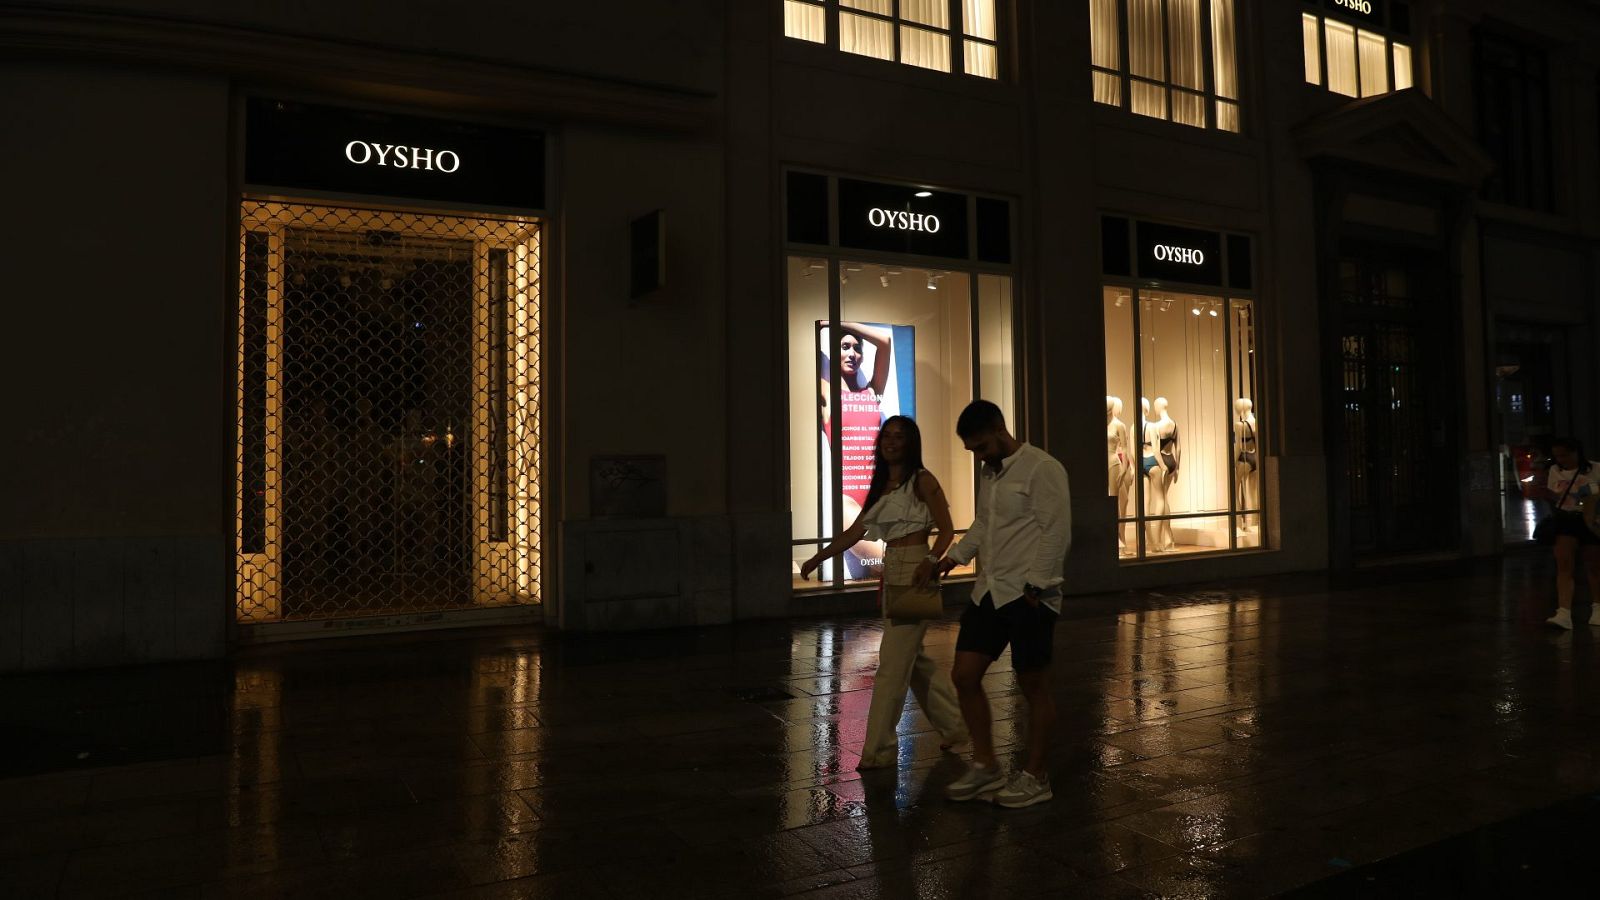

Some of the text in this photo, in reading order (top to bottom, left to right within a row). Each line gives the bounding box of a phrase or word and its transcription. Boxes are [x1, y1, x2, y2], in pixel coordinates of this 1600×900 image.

[346, 140, 460, 173] OYSHO
[868, 207, 940, 234] OYSHO
[1153, 243, 1204, 266] OYSHO
